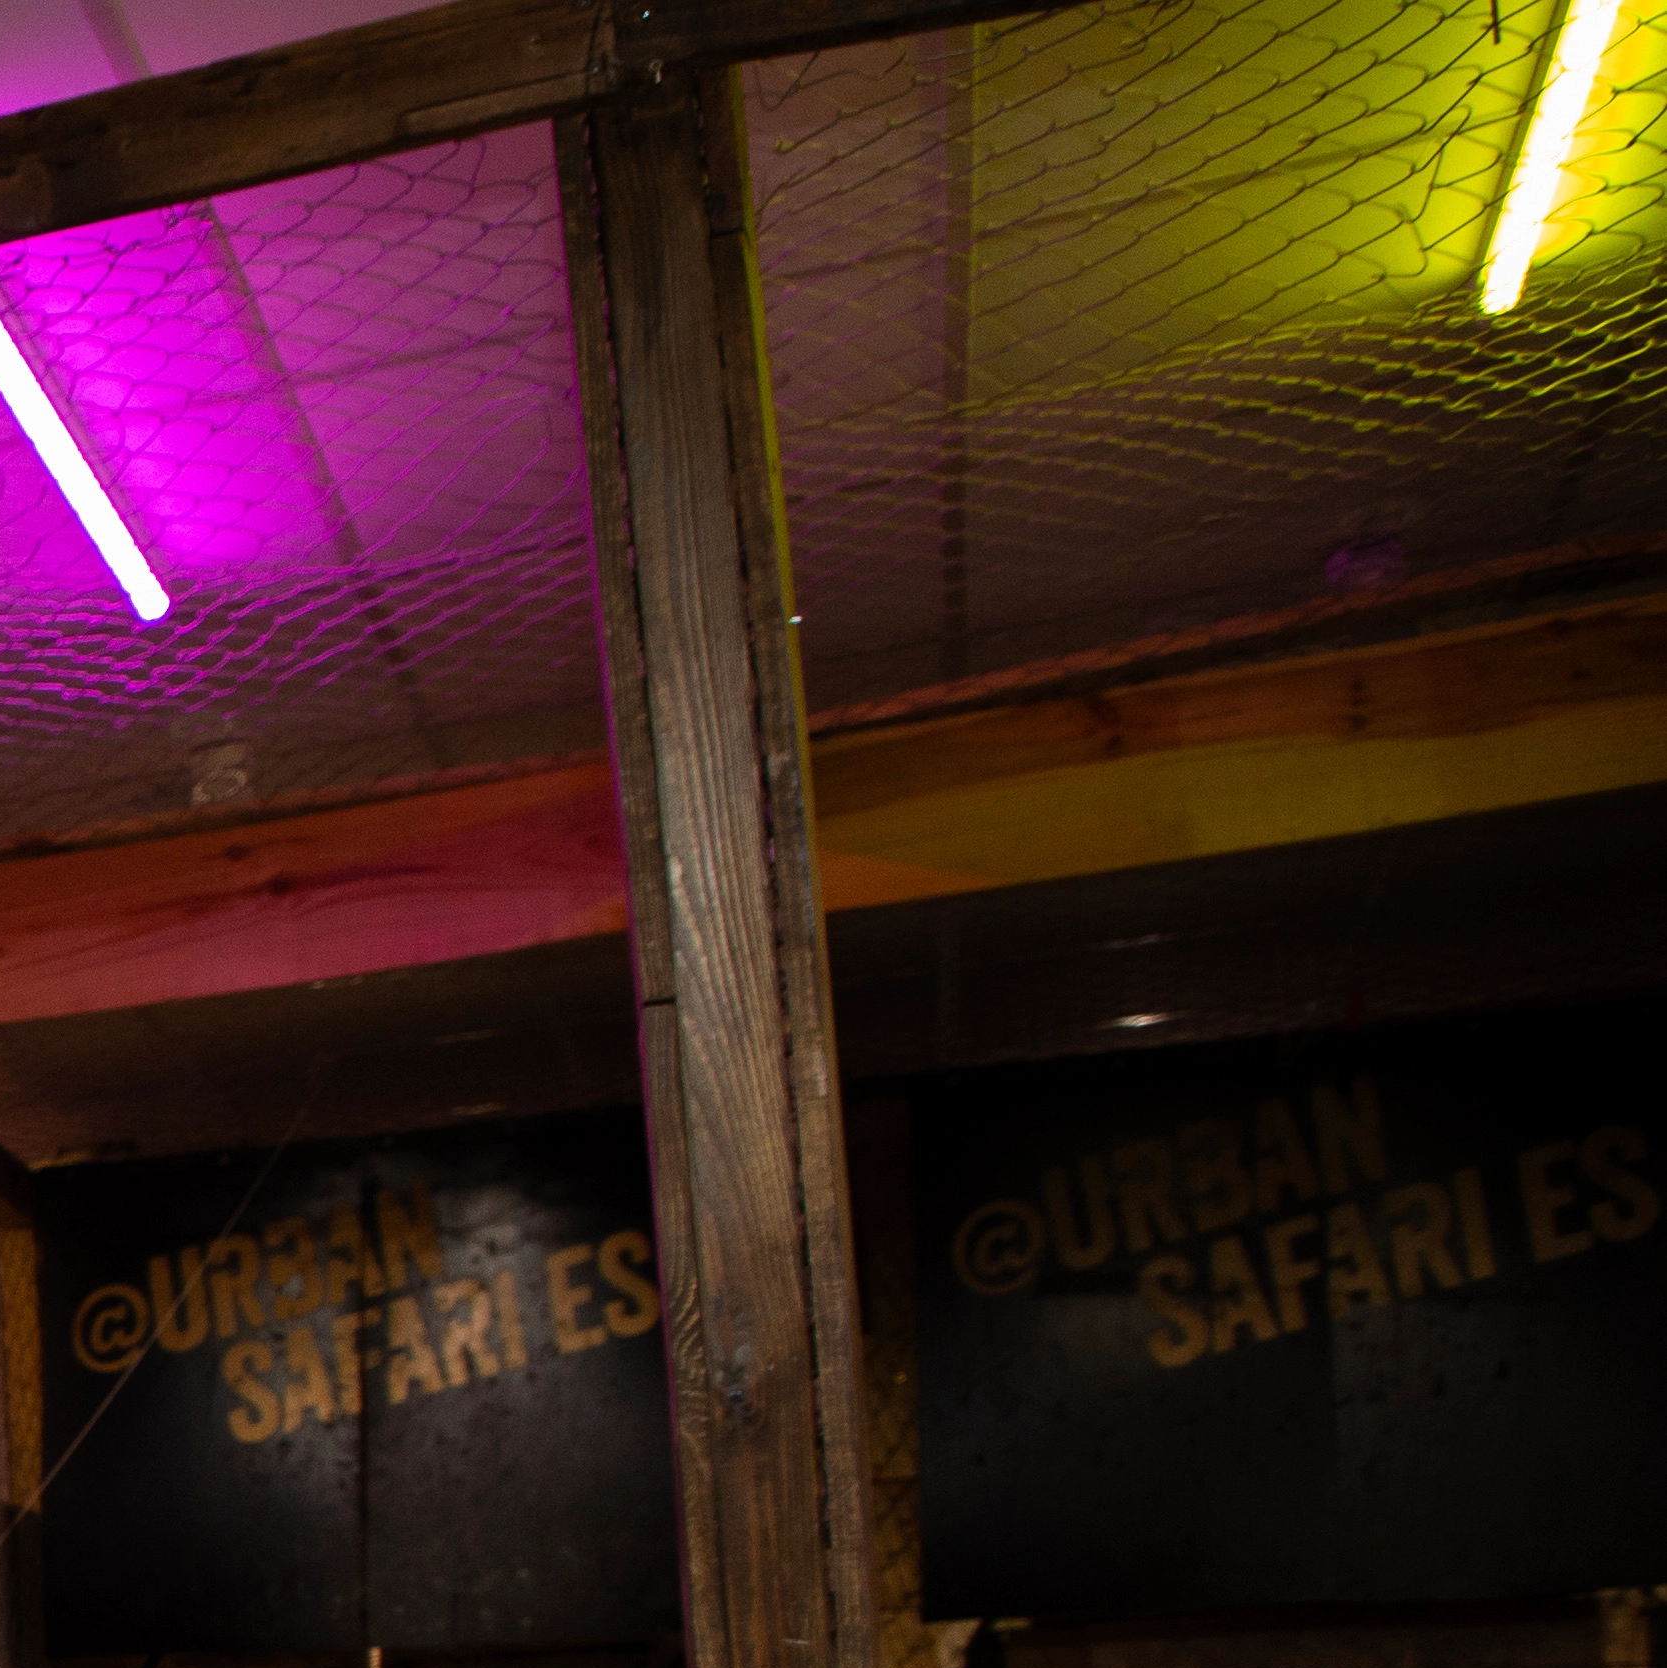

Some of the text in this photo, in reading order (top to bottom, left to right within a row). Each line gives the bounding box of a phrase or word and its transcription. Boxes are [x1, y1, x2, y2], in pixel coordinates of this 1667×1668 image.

[71, 1180, 443, 1373] @URBAN
[953, 1072, 1389, 1294] @URBAN
[1138, 1122, 1664, 1369] SAFARI ES
[222, 1229, 664, 1443] SAFARI ES
